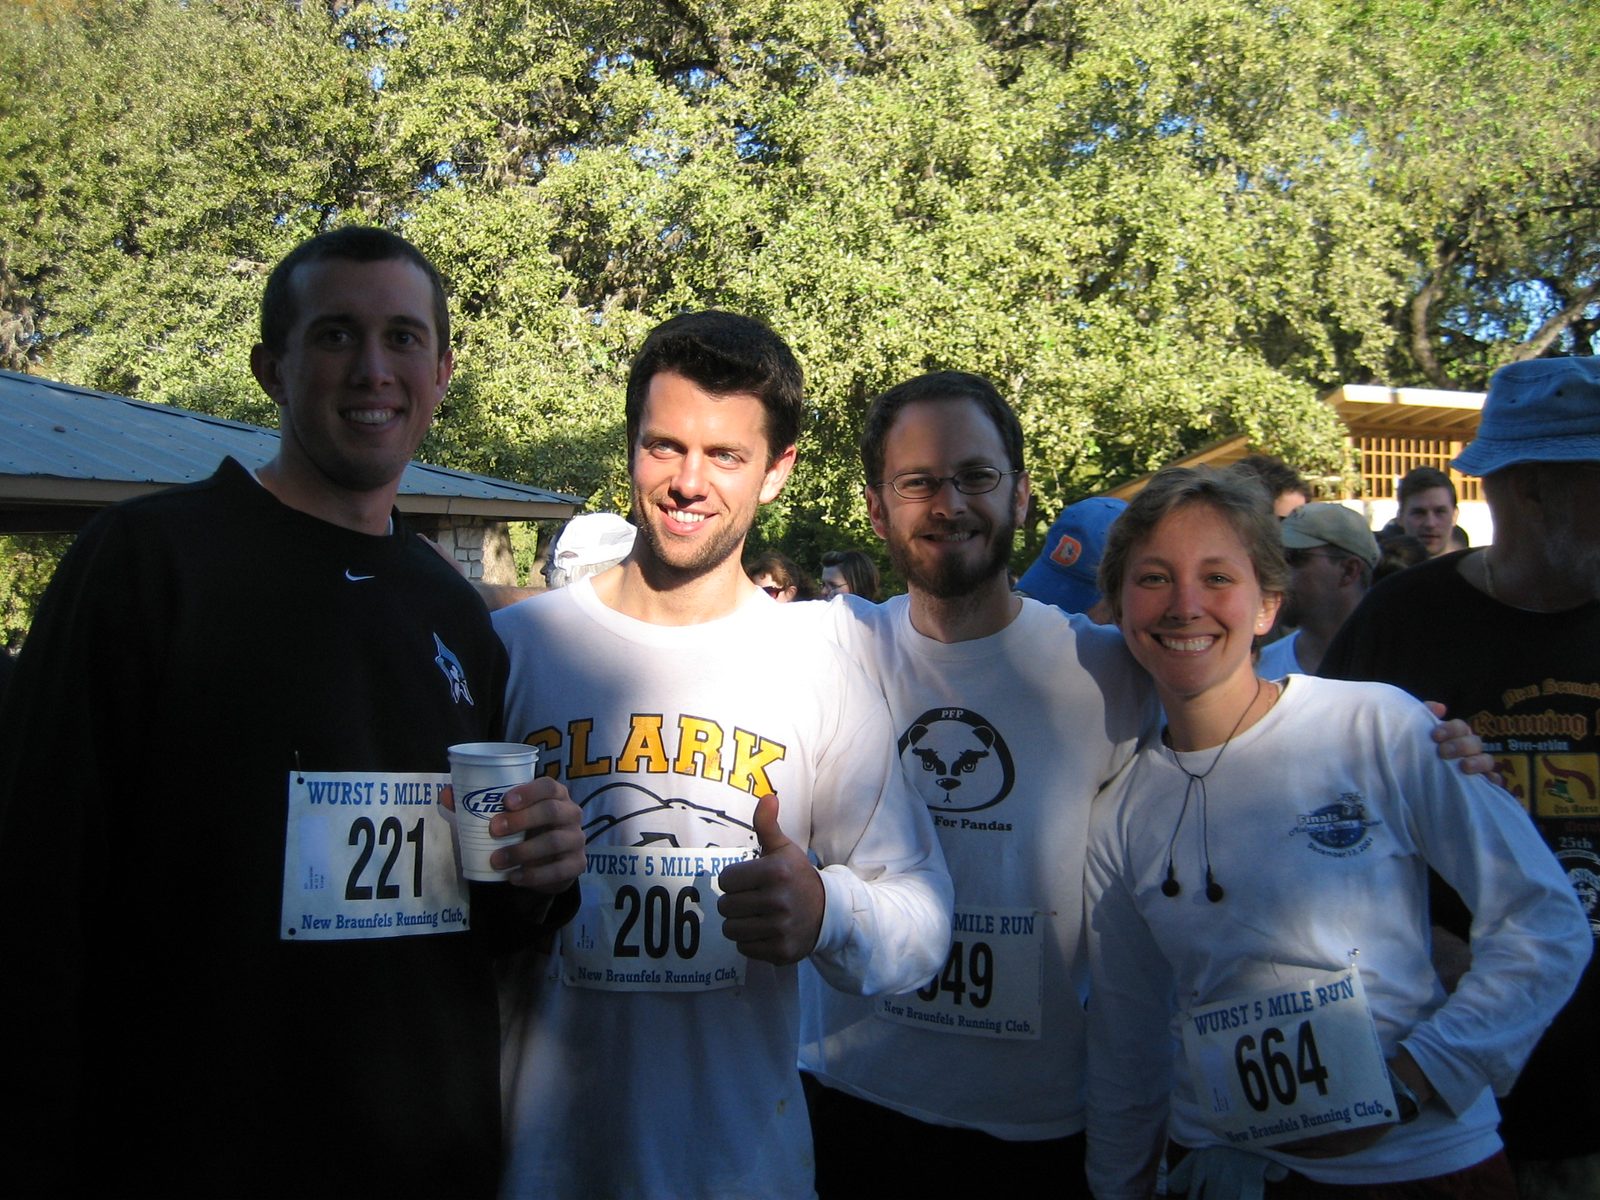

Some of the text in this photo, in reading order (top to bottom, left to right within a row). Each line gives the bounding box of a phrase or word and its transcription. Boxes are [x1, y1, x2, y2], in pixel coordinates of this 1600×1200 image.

[941, 709, 964, 719] PFP
[1471, 709, 1588, 741] Running
[523, 713, 786, 799] CLARK
[307, 781, 374, 805] WURST
[380, 783, 389, 805] 5
[394, 783, 431, 805] MILE
[934, 815, 1012, 831] For Pandas
[1298, 813, 1340, 826] Finals
[344, 816, 424, 900] 221
[645, 857, 655, 876] 5
[661, 857, 705, 877] MILE
[301, 907, 463, 930] New Braunfels Running Club
[613, 884, 701, 960] 206
[953, 913, 1035, 935] MILE RUN
[578, 966, 737, 985] New Braunfels Running Club
[884, 1000, 1030, 1034] New Braunfels Running Club
[1194, 975, 1355, 1036] WURST 5 MILE RUN
[1234, 1019, 1329, 1112] 664
[1225, 1099, 1384, 1143] New Braunfels Running Club
